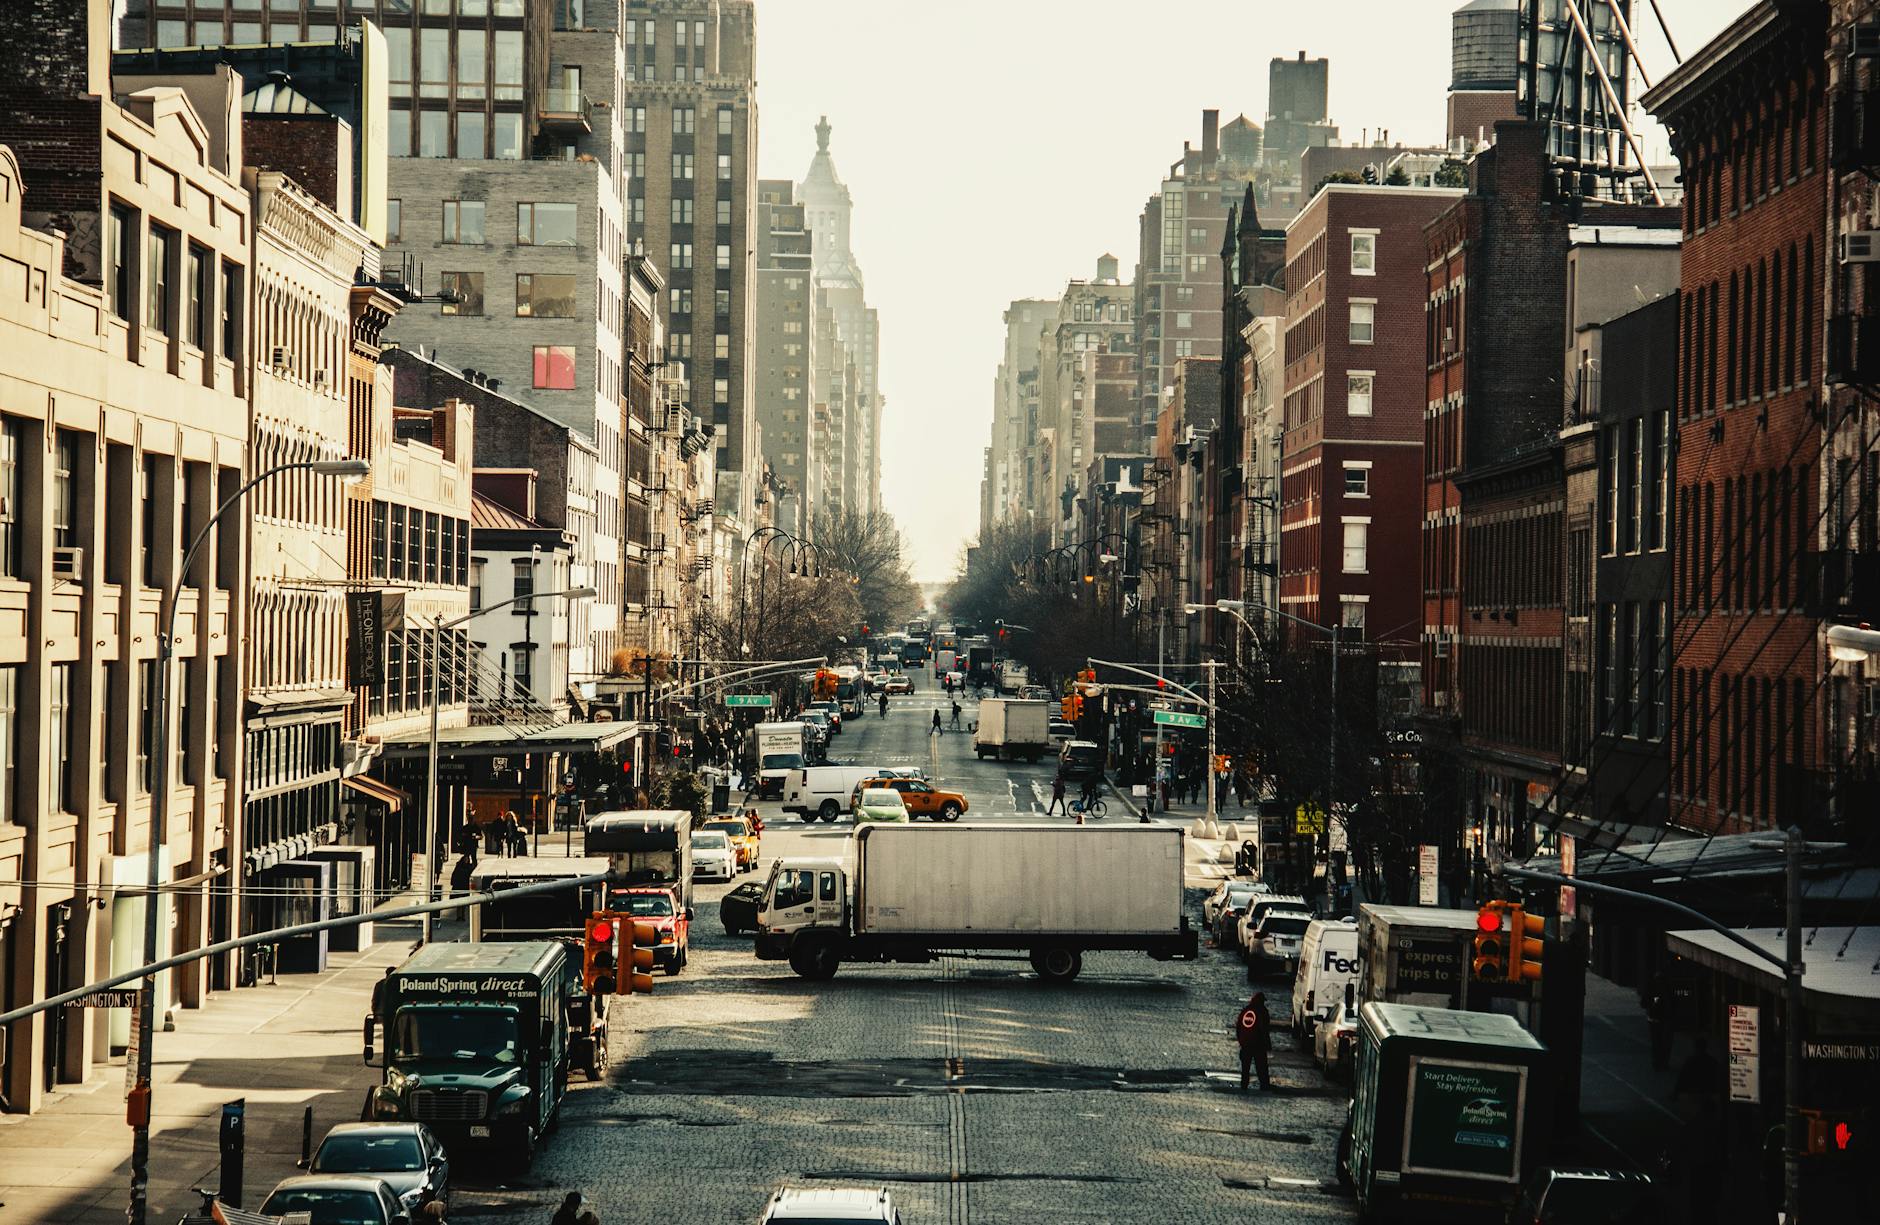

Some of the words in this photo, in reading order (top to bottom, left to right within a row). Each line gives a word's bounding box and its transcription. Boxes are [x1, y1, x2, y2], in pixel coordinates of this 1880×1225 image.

[1435, 968, 1449, 980] to
[400, 978, 438, 993] Poland
[439, 977, 478, 994] Spring
[480, 977, 525, 991] direct
[124, 993, 136, 1008] ST
[1808, 1044, 1866, 1060] WASHINGTON
[1869, 1045, 1880, 1061] ST
[1424, 1071, 1444, 1081] Start
[1446, 1073, 1480, 1084] Delivery
[1436, 1081, 1454, 1092] Stay
[1455, 1083, 1497, 1095] Refreshed
[230, 1116, 239, 1128] P
